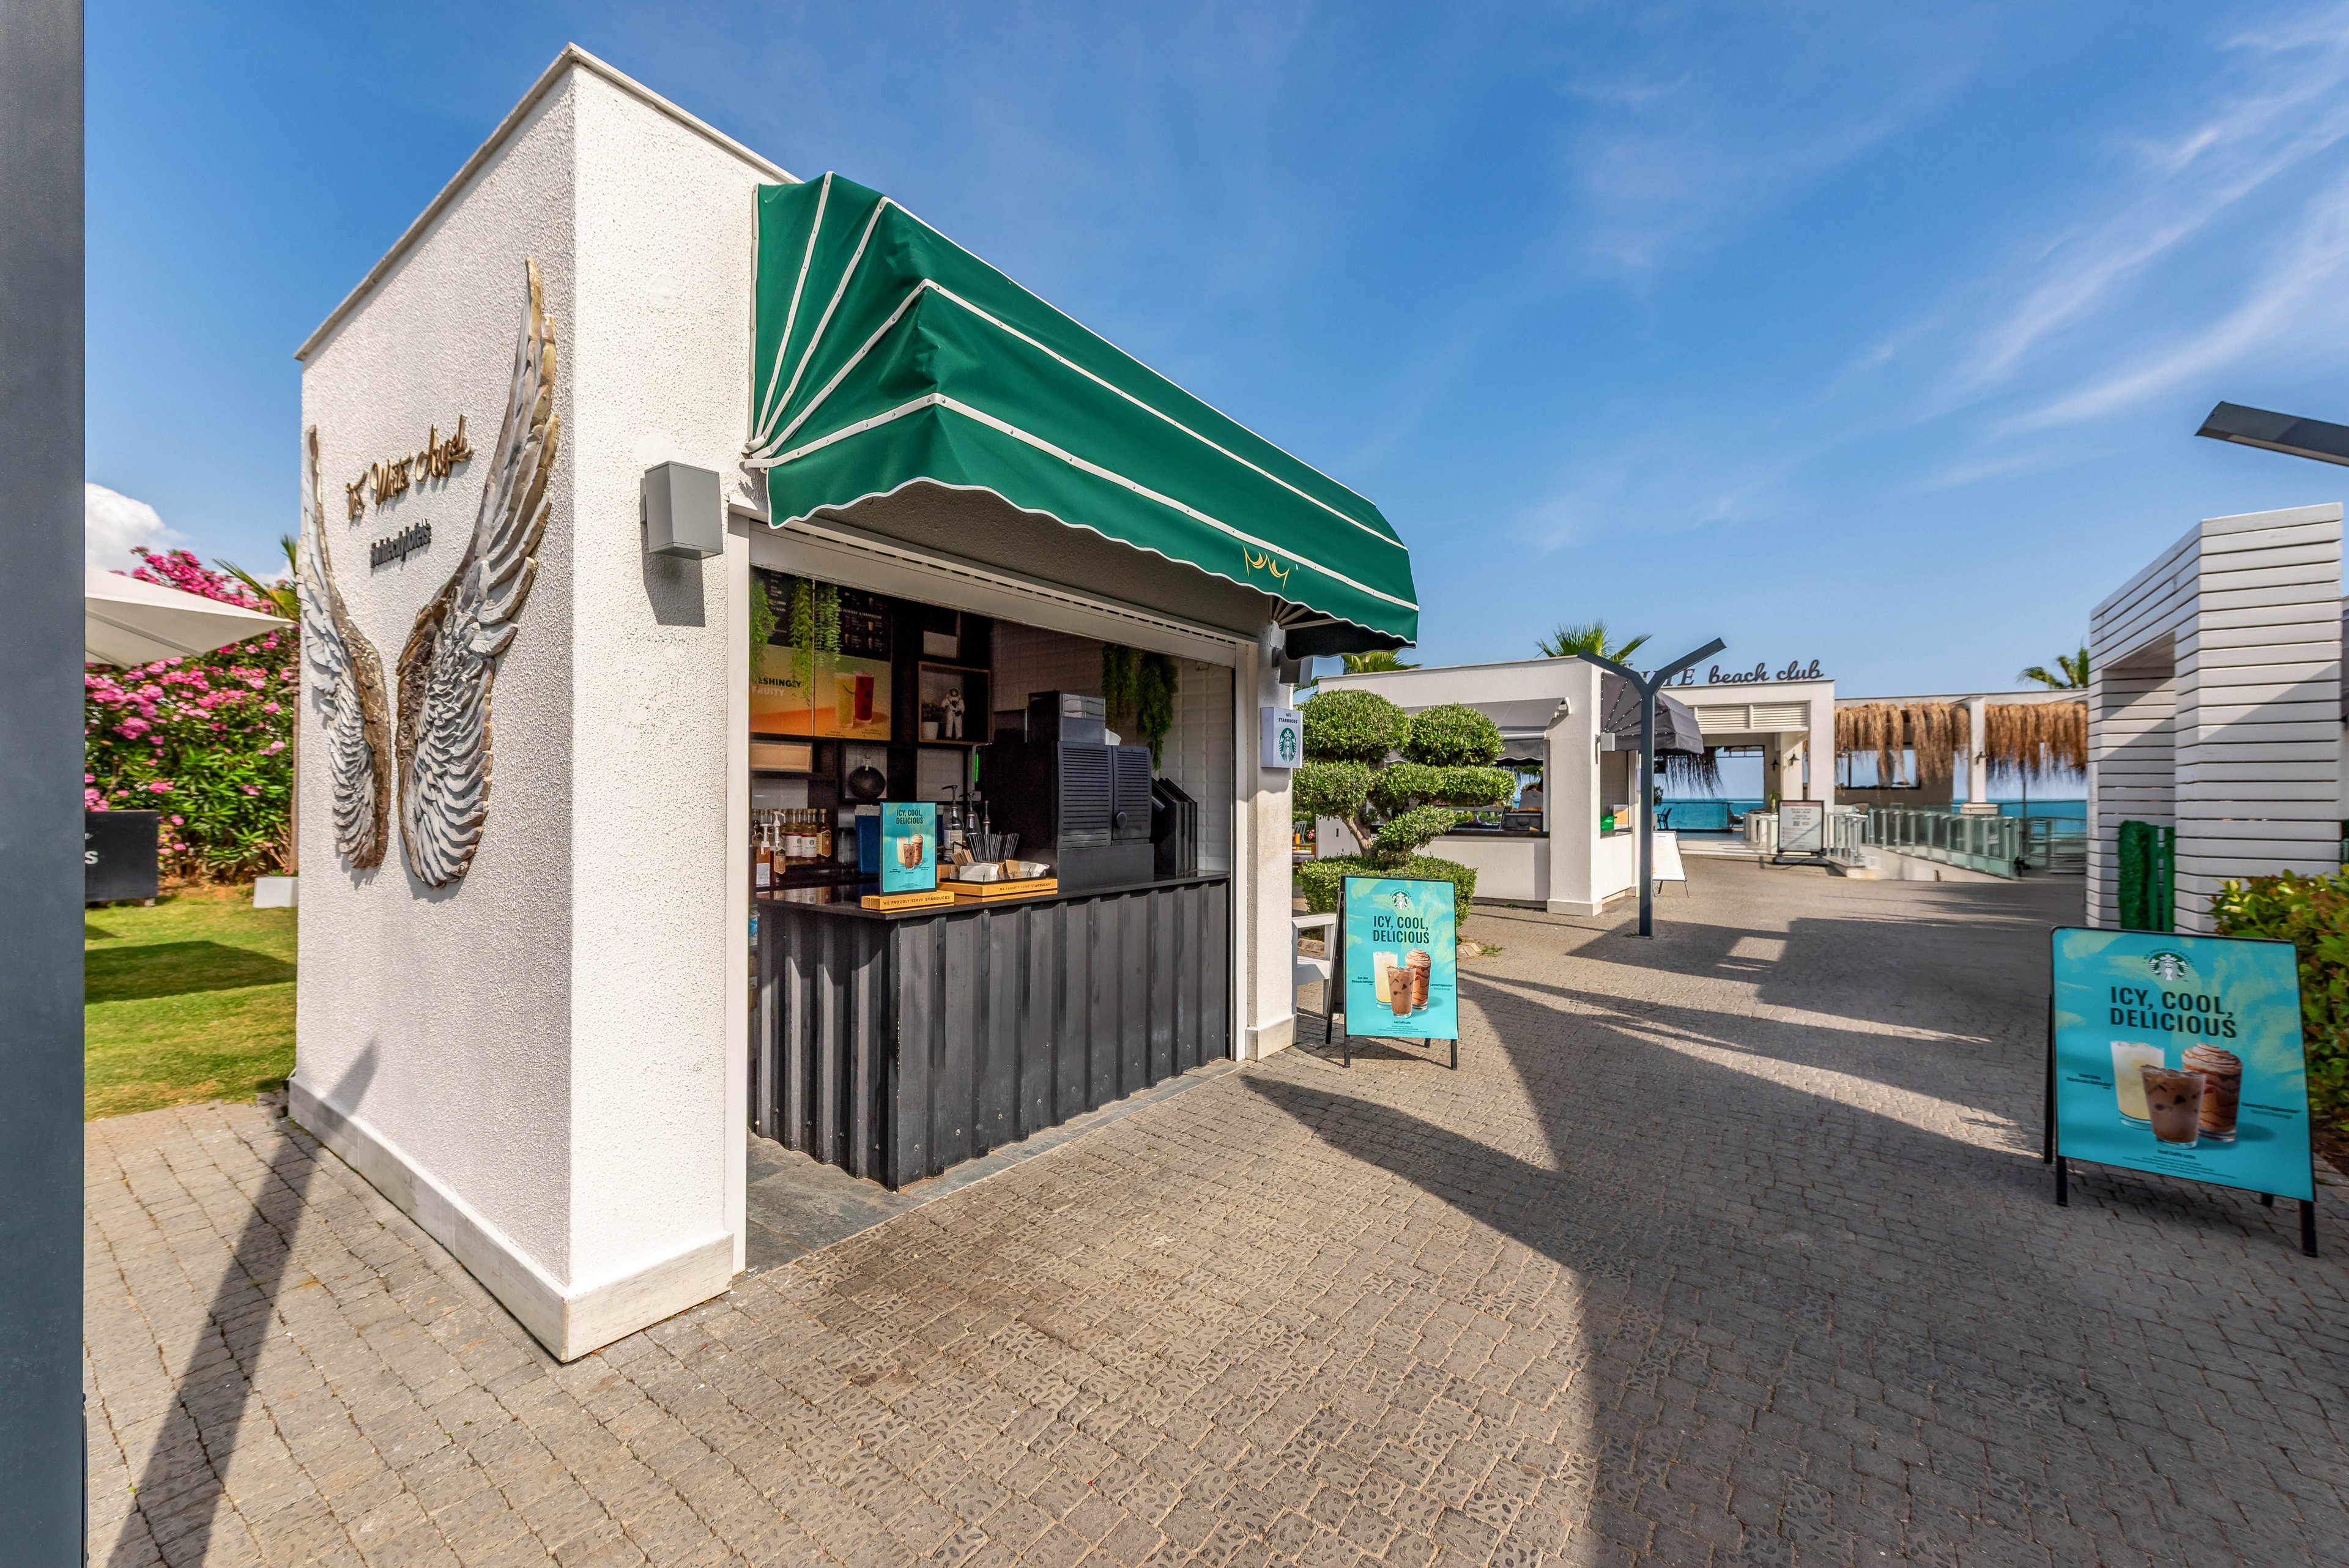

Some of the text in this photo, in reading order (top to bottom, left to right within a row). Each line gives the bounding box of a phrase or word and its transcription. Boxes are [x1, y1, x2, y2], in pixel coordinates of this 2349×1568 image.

[1709, 663, 1770, 685] beach
[1776, 659, 1825, 681] club
[751, 686, 784, 696] FRUITY
[1374, 915, 1428, 932] ICY, COOL,
[1373, 930, 1430, 944] DELICIOUS
[2110, 986, 2234, 1019] ICY, COOL,
[2110, 1007, 2238, 1038] DELICIOUS
